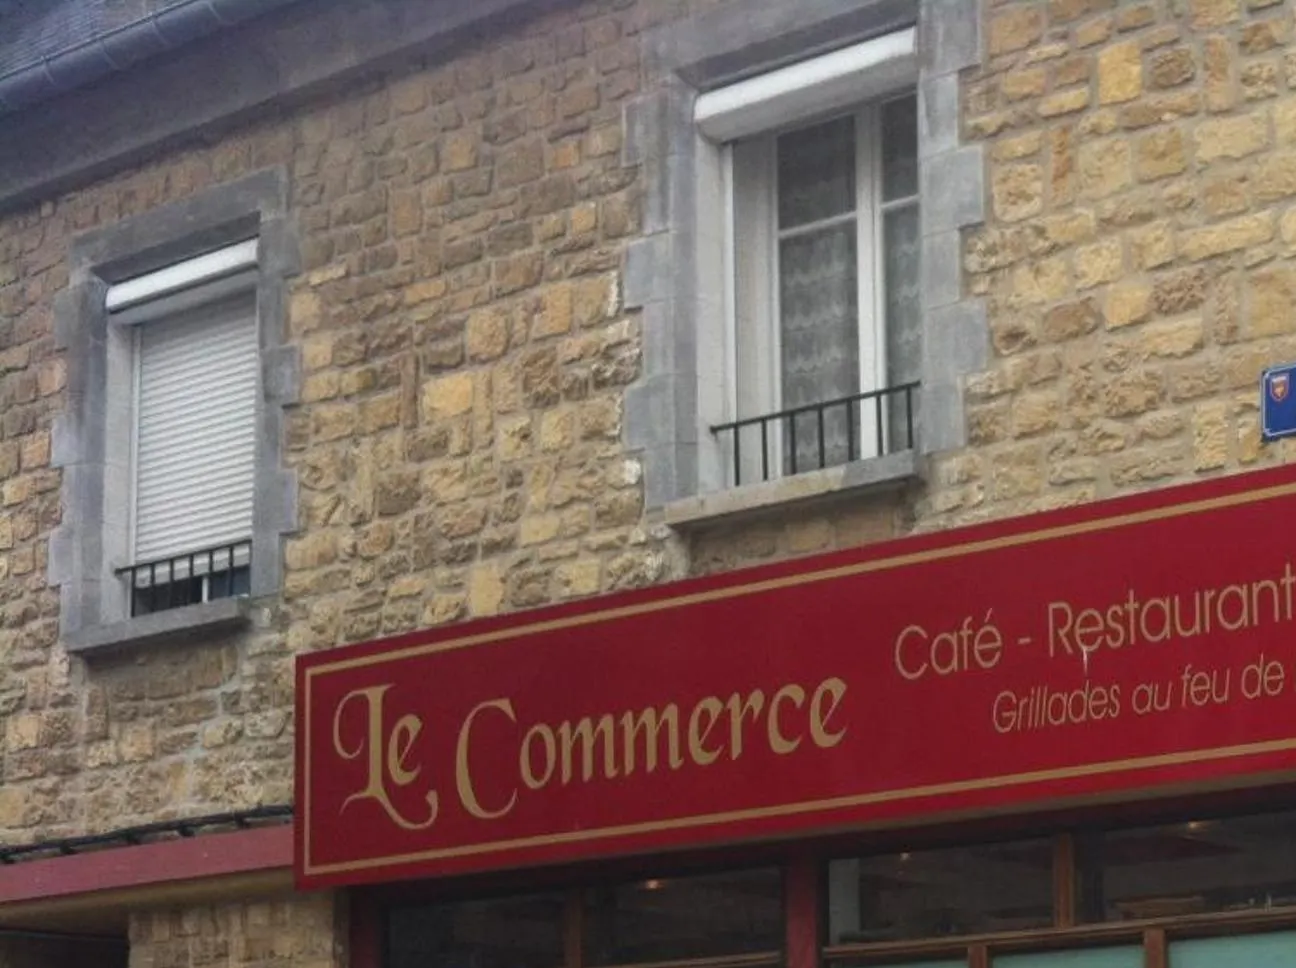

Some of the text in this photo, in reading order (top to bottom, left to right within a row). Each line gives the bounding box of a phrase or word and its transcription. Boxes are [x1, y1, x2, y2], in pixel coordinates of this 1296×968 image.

[895, 608, 1002, 681] Café
[1048, 562, 1296, 658] Restaurant
[332, 677, 848, 831] Le Commerce
[993, 674, 1121, 736] Grillades
[1131, 682, 1171, 715] au
[1180, 664, 1230, 709] feu
[1240, 653, 1285, 700] de
